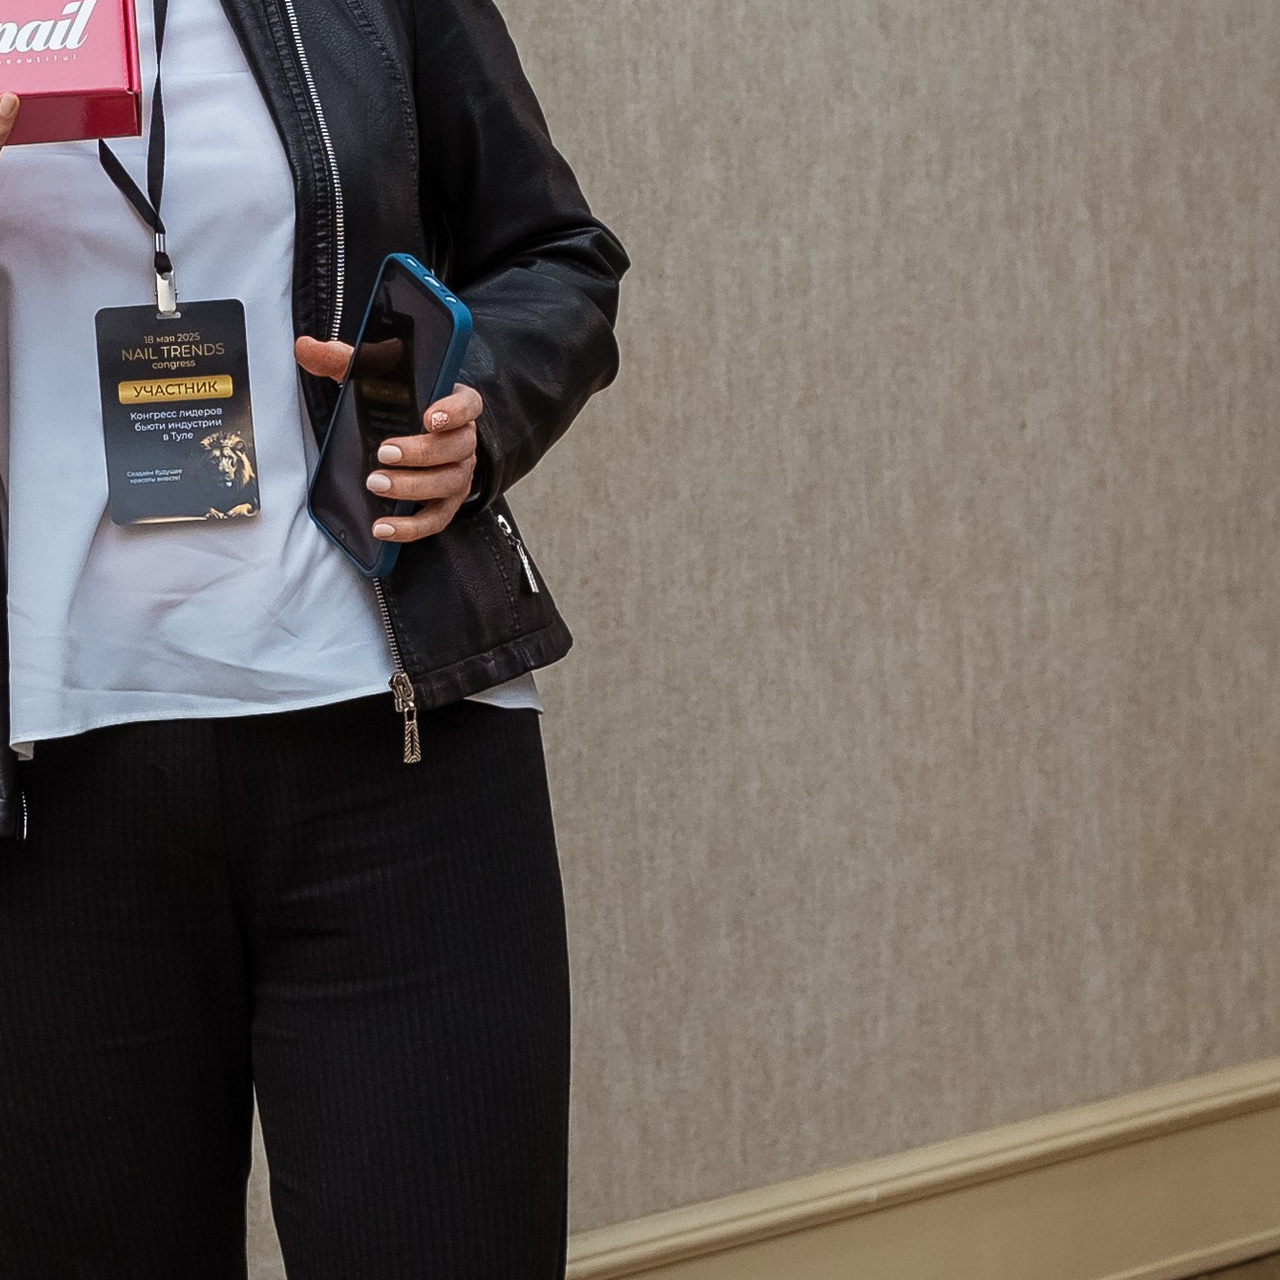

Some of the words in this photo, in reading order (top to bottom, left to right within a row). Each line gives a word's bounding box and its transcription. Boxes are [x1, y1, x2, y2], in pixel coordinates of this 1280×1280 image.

[143, 335, 154, 344] 18
[156, 335, 176, 344] мая
[177, 332, 201, 342] 2025
[121, 346, 159, 361] NAIL
[160, 342, 225, 359] TRENDS
[151, 359, 196, 371] congress
[133, 380, 218, 398] УЧАСТНИК
[130, 410, 177, 421] Конгресс
[179, 407, 223, 418] лидеров
[134, 422, 166, 432] бьюти
[168, 419, 223, 430] индустрии
[163, 433, 169, 441] в
[170, 431, 194, 442] Туле
